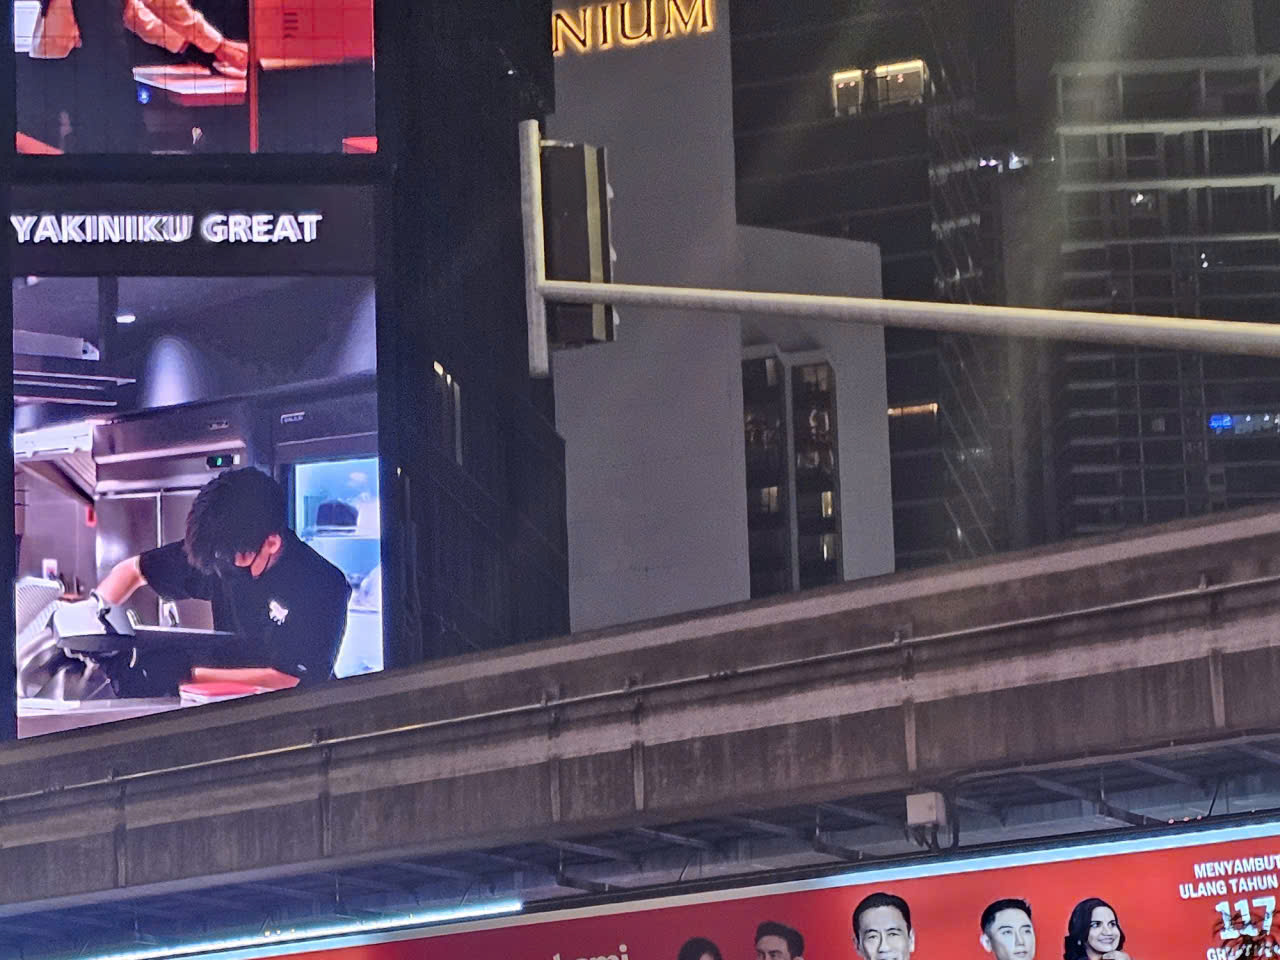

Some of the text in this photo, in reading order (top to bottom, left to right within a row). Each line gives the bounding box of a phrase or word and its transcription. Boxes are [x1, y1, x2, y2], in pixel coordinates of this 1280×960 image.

[10, 213, 323, 243] YAKINIKU GREAT
[1194, 855, 1280, 879] MENYAMBUT
[1179, 874, 1278, 899] ULANG TAHUN
[1215, 896, 1277, 940] 117
